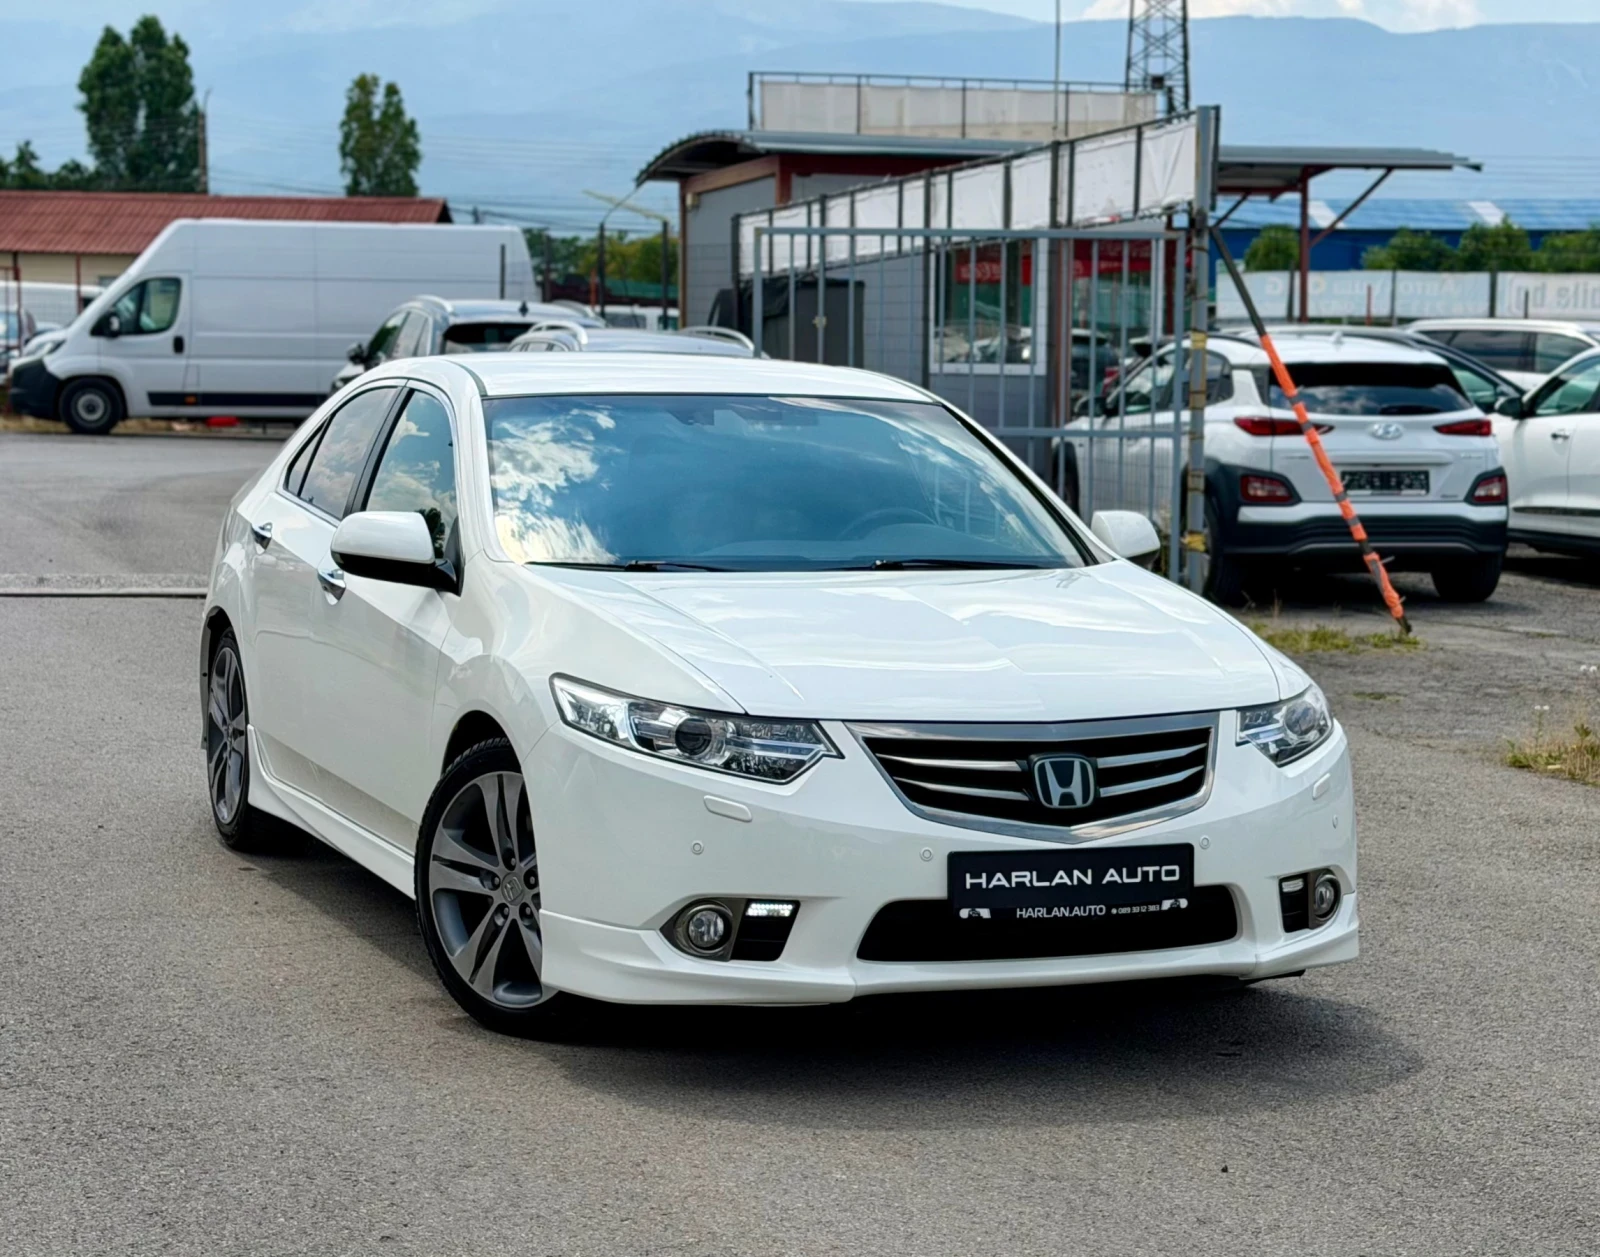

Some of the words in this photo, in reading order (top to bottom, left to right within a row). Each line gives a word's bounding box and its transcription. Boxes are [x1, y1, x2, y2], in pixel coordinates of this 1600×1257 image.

[965, 869, 1092, 889] HARLAN
[1102, 865, 1180, 884] AUTO
[1016, 905, 1106, 918] HARLAN.AUTO
